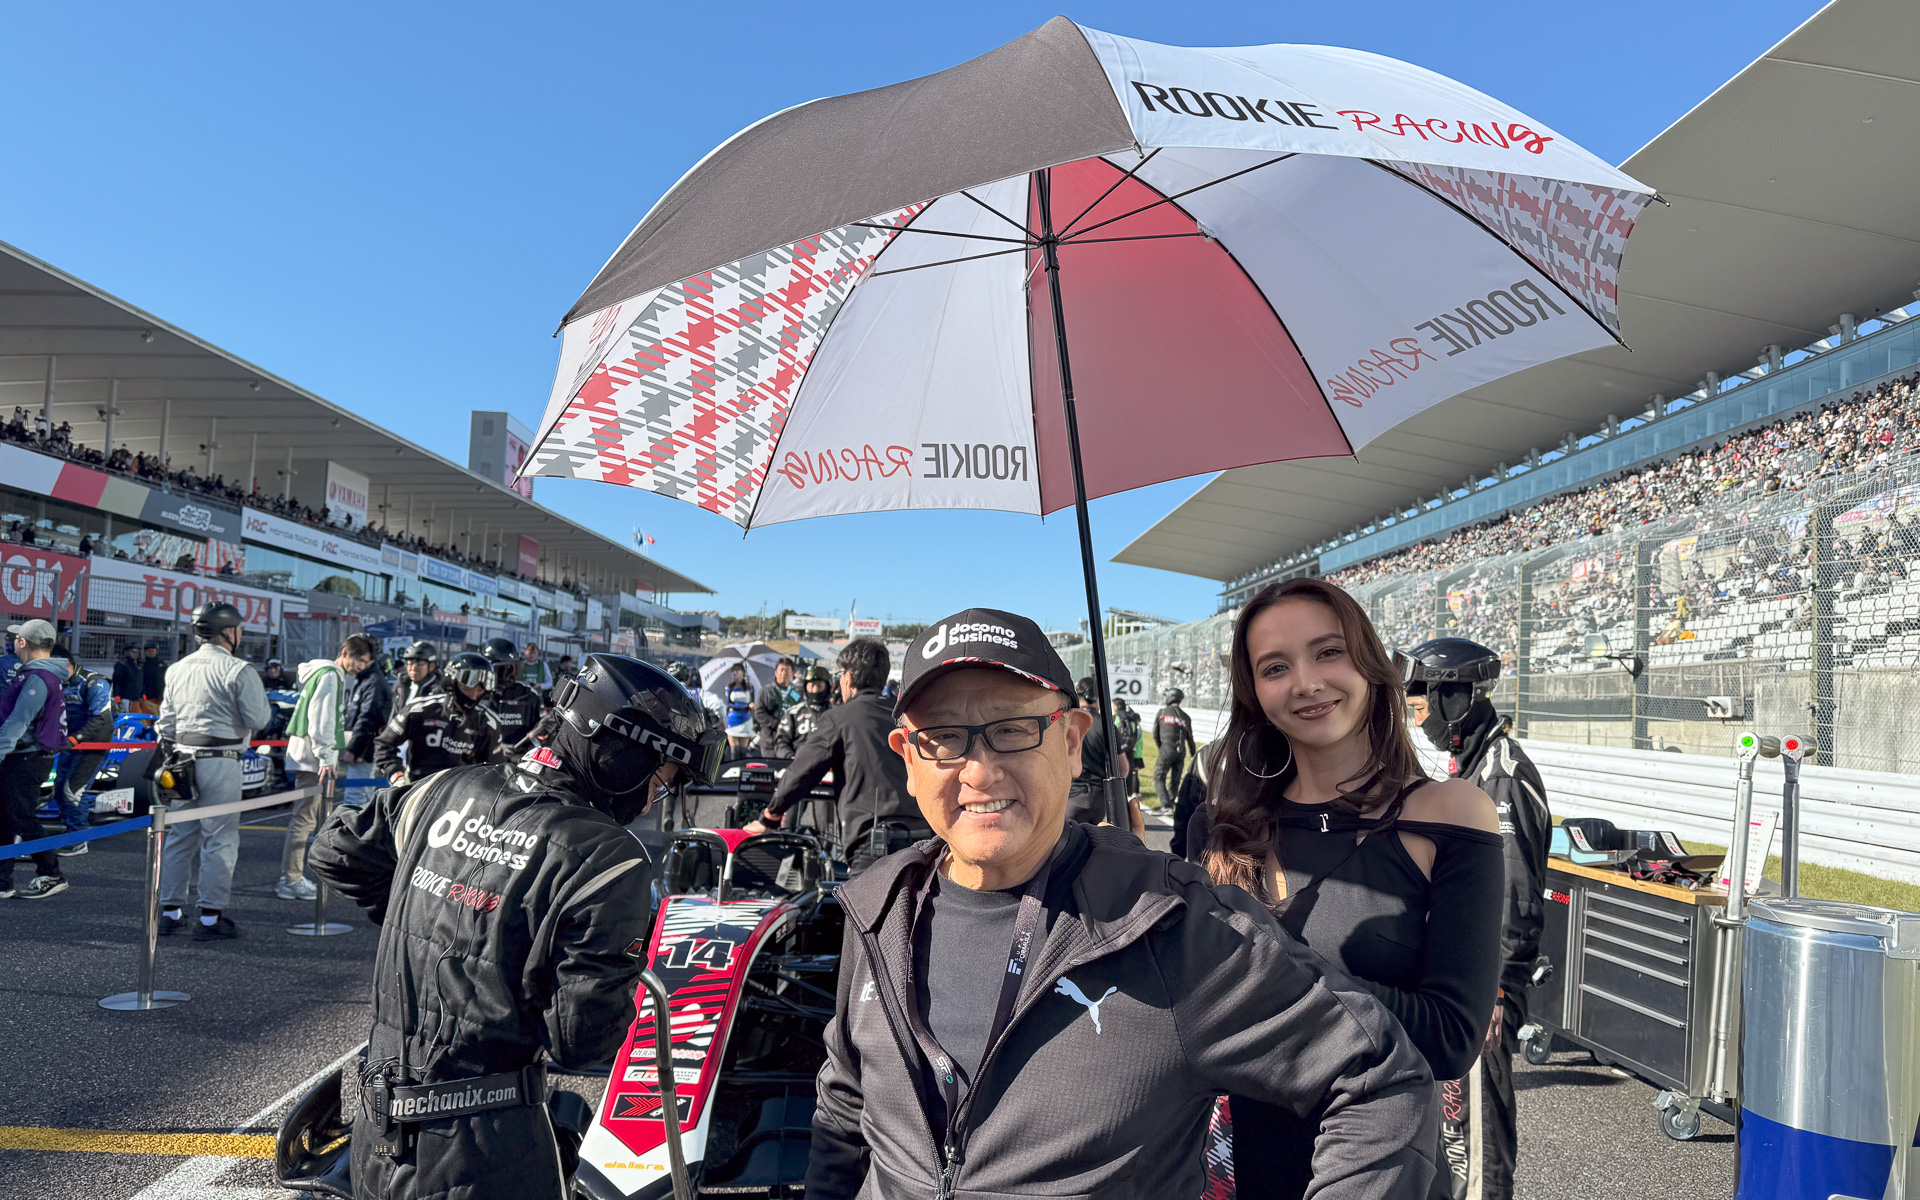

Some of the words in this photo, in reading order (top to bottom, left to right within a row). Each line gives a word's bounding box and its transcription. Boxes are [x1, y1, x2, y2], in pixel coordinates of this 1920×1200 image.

[1131, 80, 1339, 130] ROOKIE
[1337, 110, 1554, 155] RACING
[0, 553, 63, 609] GK
[949, 623, 1016, 639] docomo
[949, 631, 1018, 650] business
[1114, 679, 1142, 695] 20
[603, 713, 692, 765] GIRO
[464, 815, 538, 850] docomo
[451, 831, 530, 870] business
[664, 939, 734, 970] 14
[1019, 932, 1032, 963] FORMULA
[604, 1161, 665, 1171] dallara
[1443, 1121, 1468, 1180] ROOKIE
